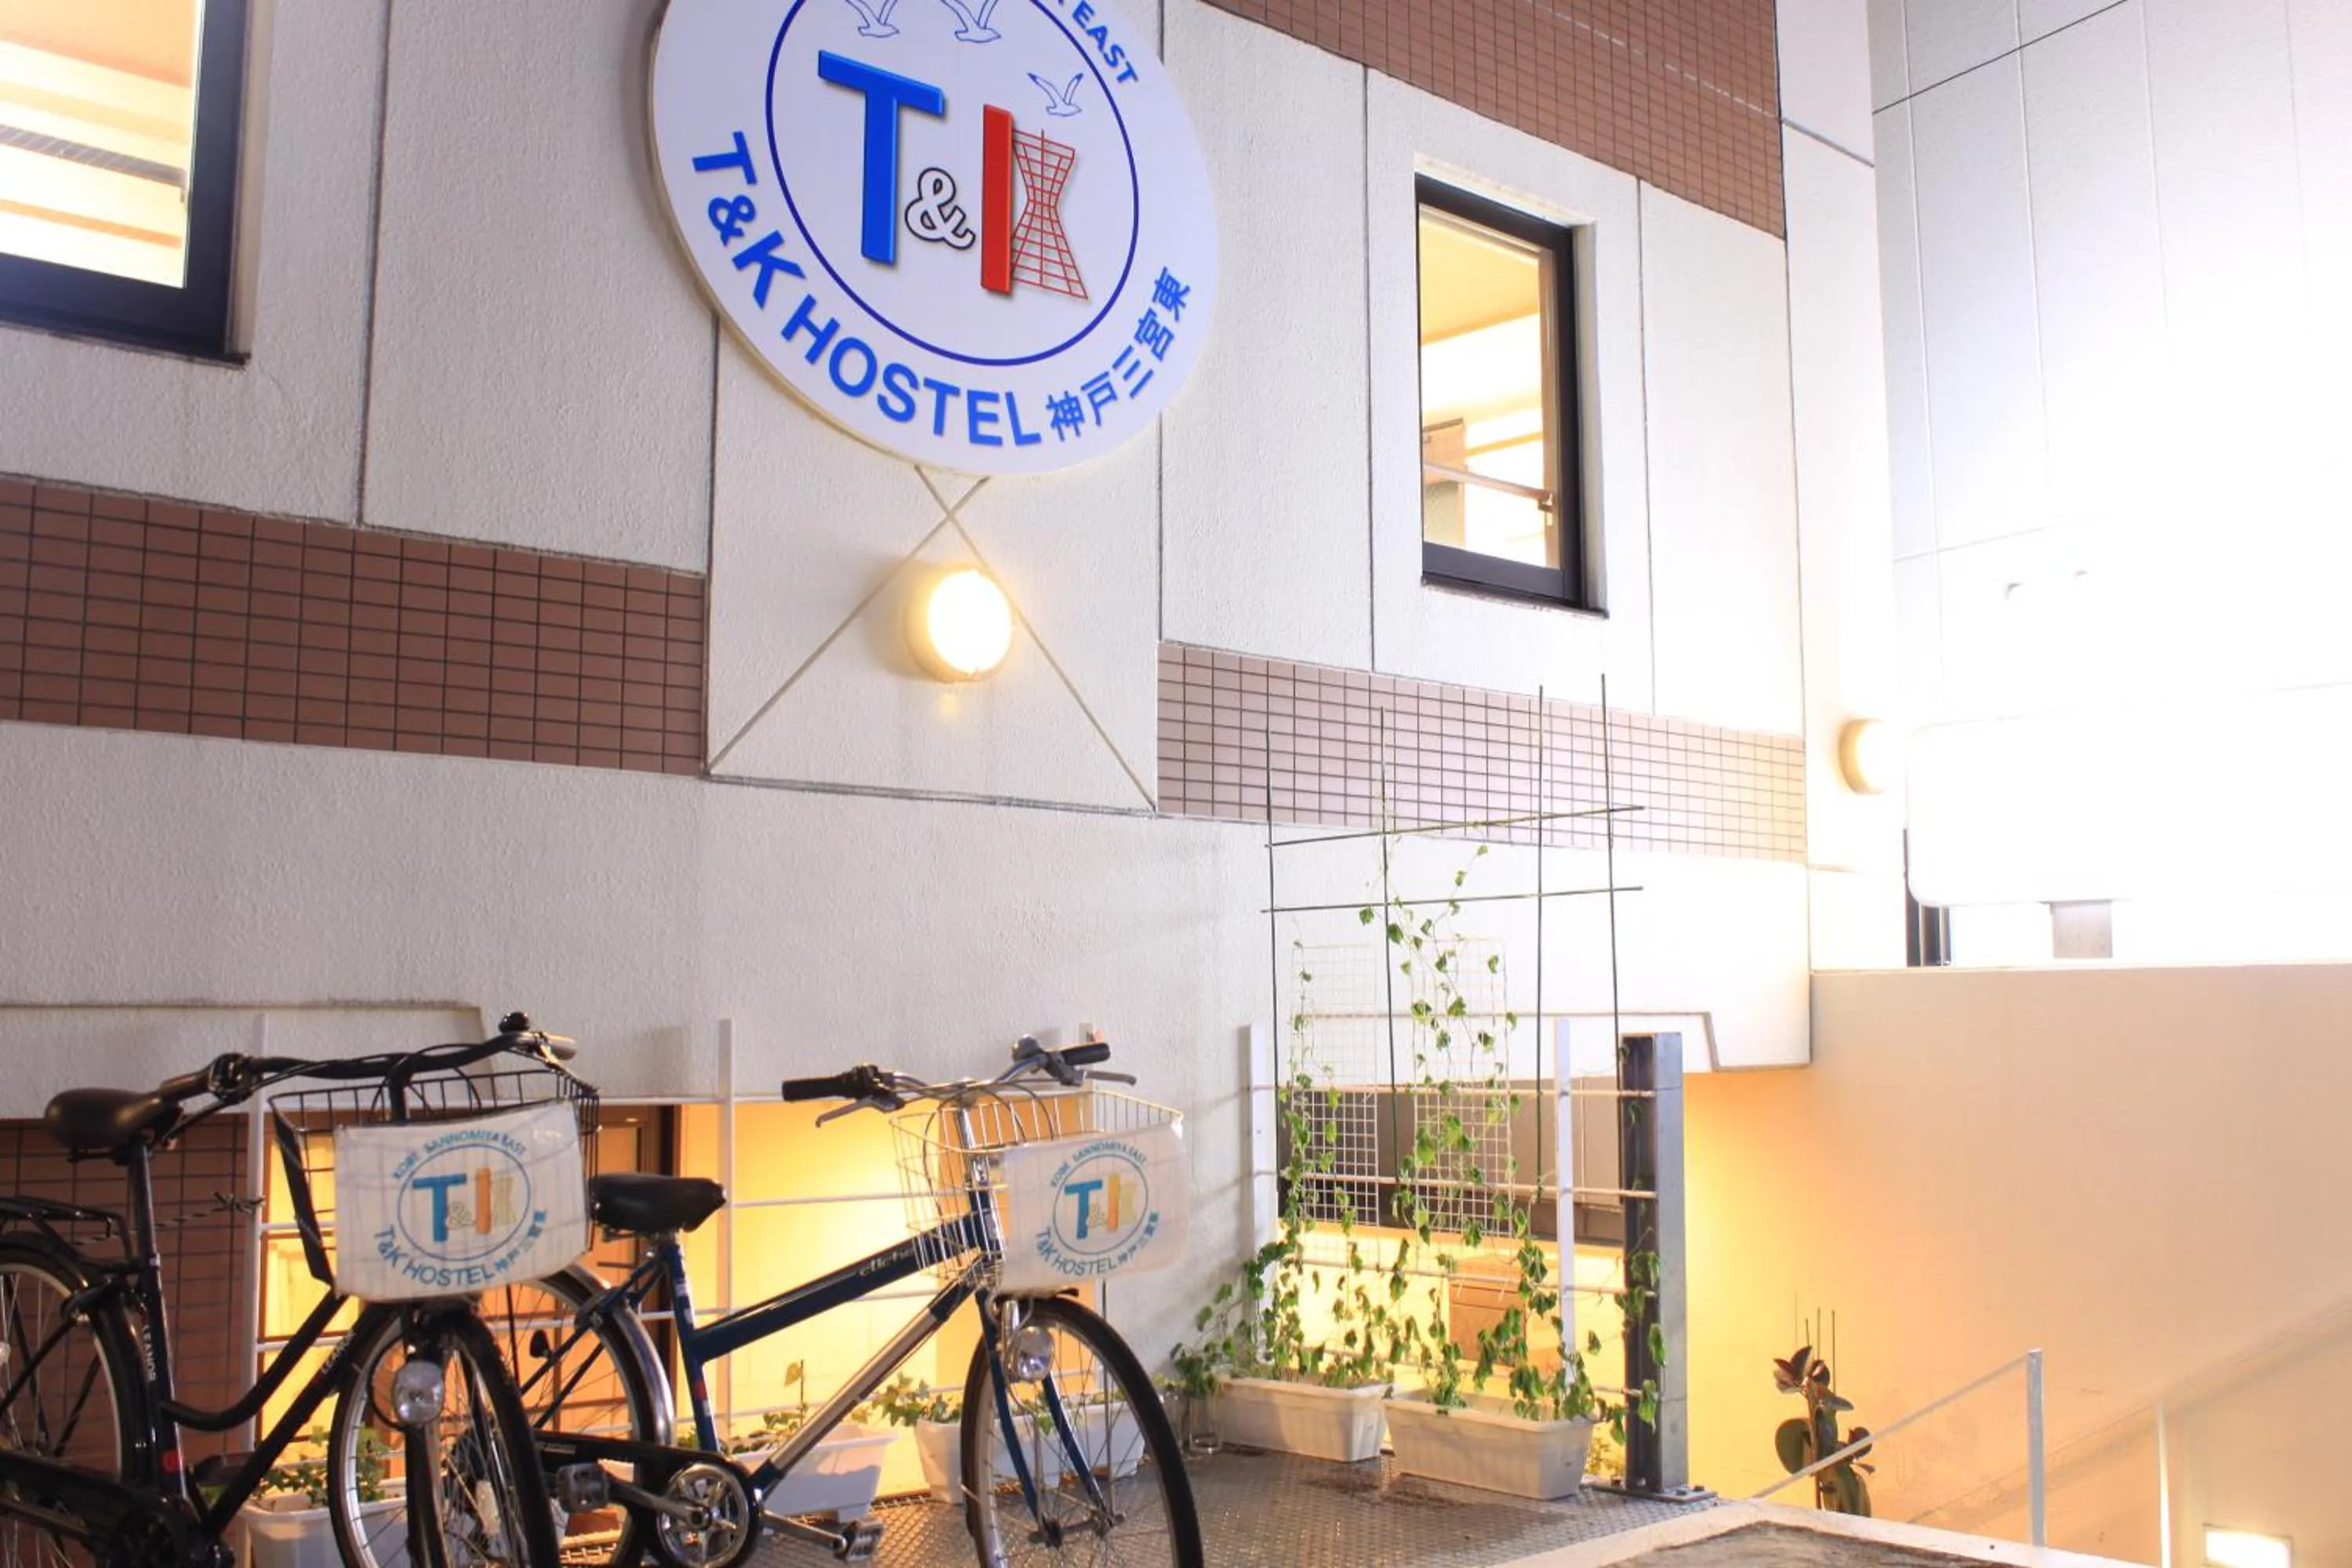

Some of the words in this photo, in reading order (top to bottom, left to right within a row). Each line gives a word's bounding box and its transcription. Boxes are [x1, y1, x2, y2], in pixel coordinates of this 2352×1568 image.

[1072, 0, 1138, 83] EAST
[692, 130, 805, 310] T&K
[780, 295, 1041, 448] HOSTEL
[1046, 267, 1191, 441] 神戸三宮東
[402, 1258, 495, 1287] HOSTEL
[1051, 1254, 1117, 1276] HOSTEL
